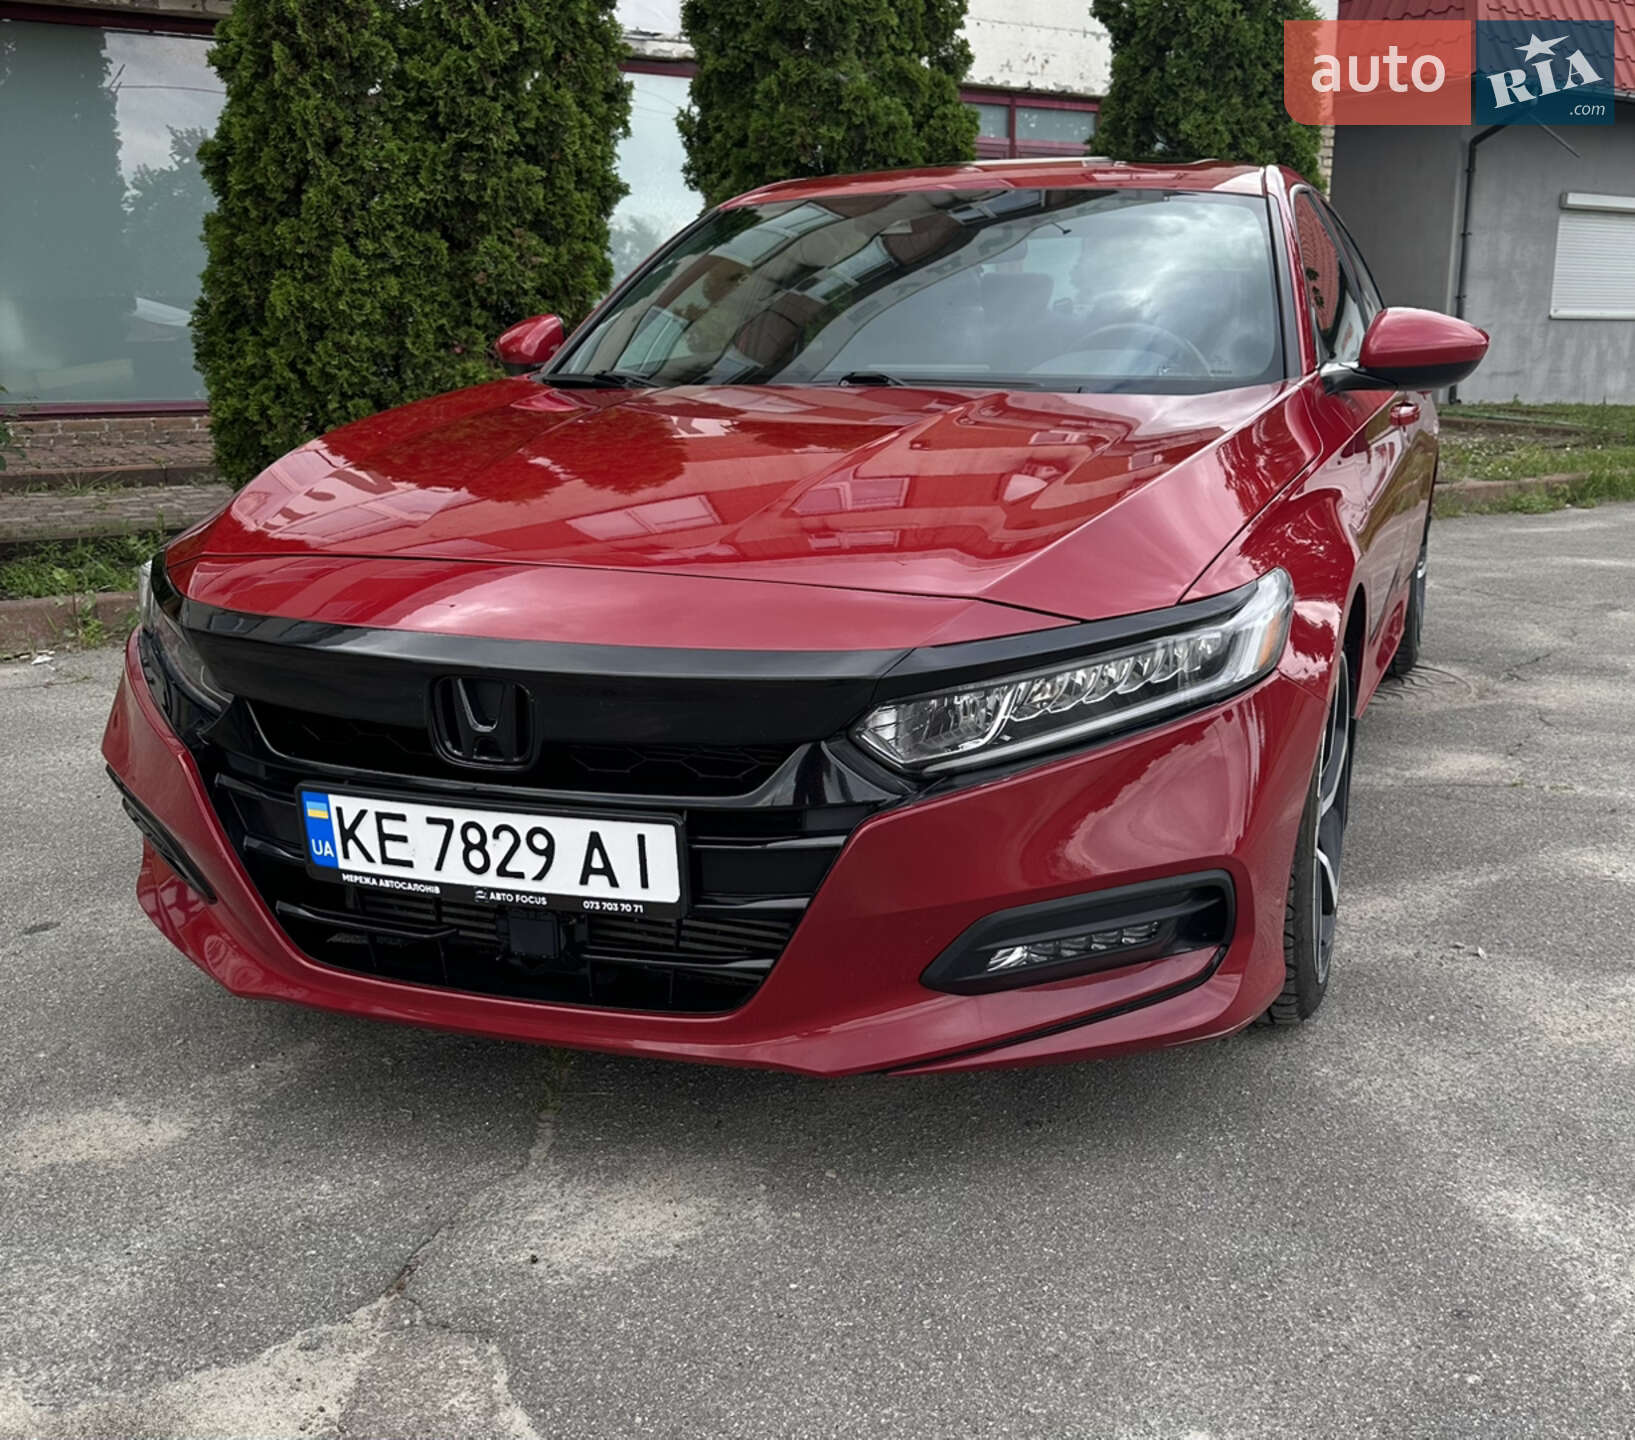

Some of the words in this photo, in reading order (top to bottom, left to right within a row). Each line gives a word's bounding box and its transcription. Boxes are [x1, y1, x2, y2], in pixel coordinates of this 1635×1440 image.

[311, 838, 334, 857] UA
[335, 807, 414, 868] KE
[426, 816, 555, 881] 7829
[342, 873, 377, 886] МЕРЕЖА
[515, 894, 547, 905] FOCUS
[583, 900, 600, 910] 073
[601, 902, 619, 911] 703
[620, 903, 632, 912] 70
[633, 904, 644, 913] 71
